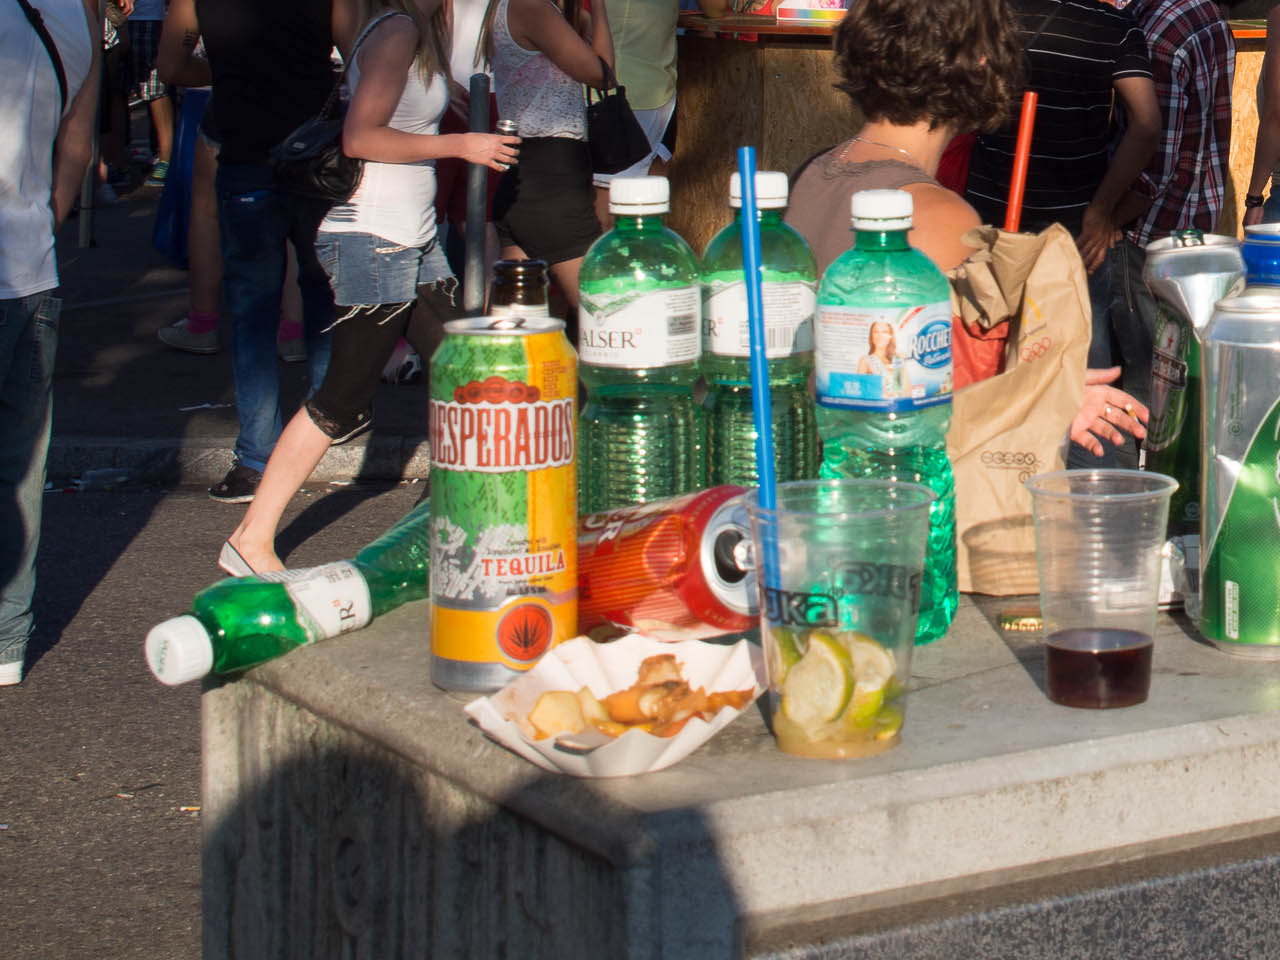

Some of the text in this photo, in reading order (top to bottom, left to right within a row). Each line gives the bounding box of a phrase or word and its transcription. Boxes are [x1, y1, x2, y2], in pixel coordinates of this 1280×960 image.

[582, 329, 637, 349] ALSER
[431, 401, 574, 467] DESPERADOS
[481, 550, 566, 577] TEQUILA
